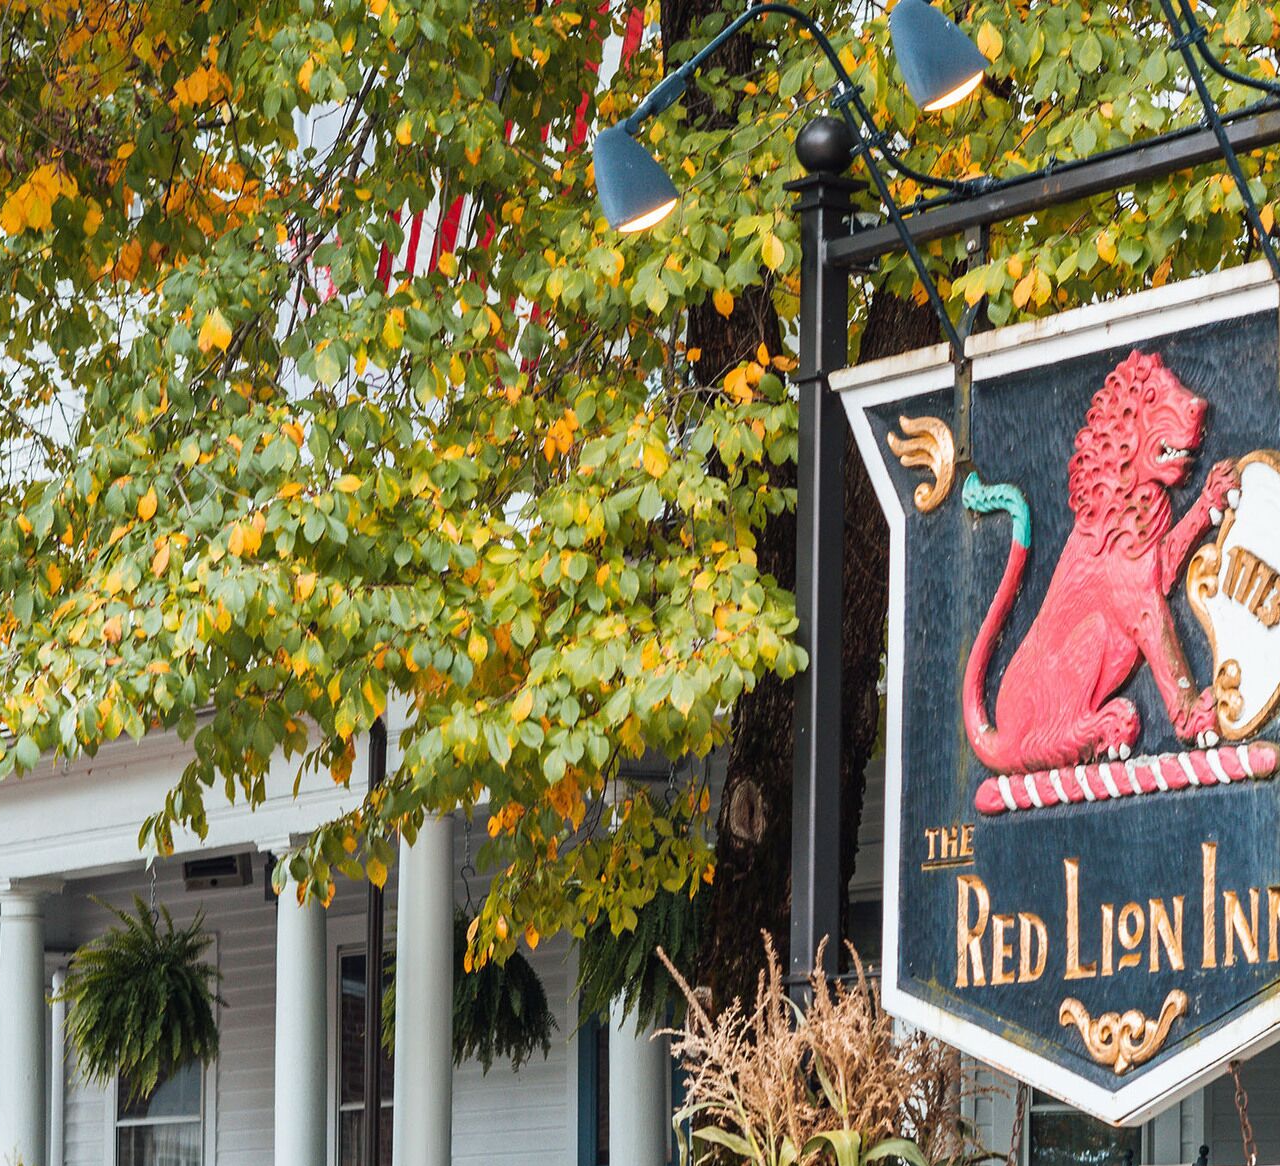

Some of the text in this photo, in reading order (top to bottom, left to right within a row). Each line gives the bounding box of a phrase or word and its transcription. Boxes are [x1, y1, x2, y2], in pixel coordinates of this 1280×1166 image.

[924, 823, 976, 860] THE
[954, 874, 1049, 988] RED
[1063, 857, 1186, 981] LION
